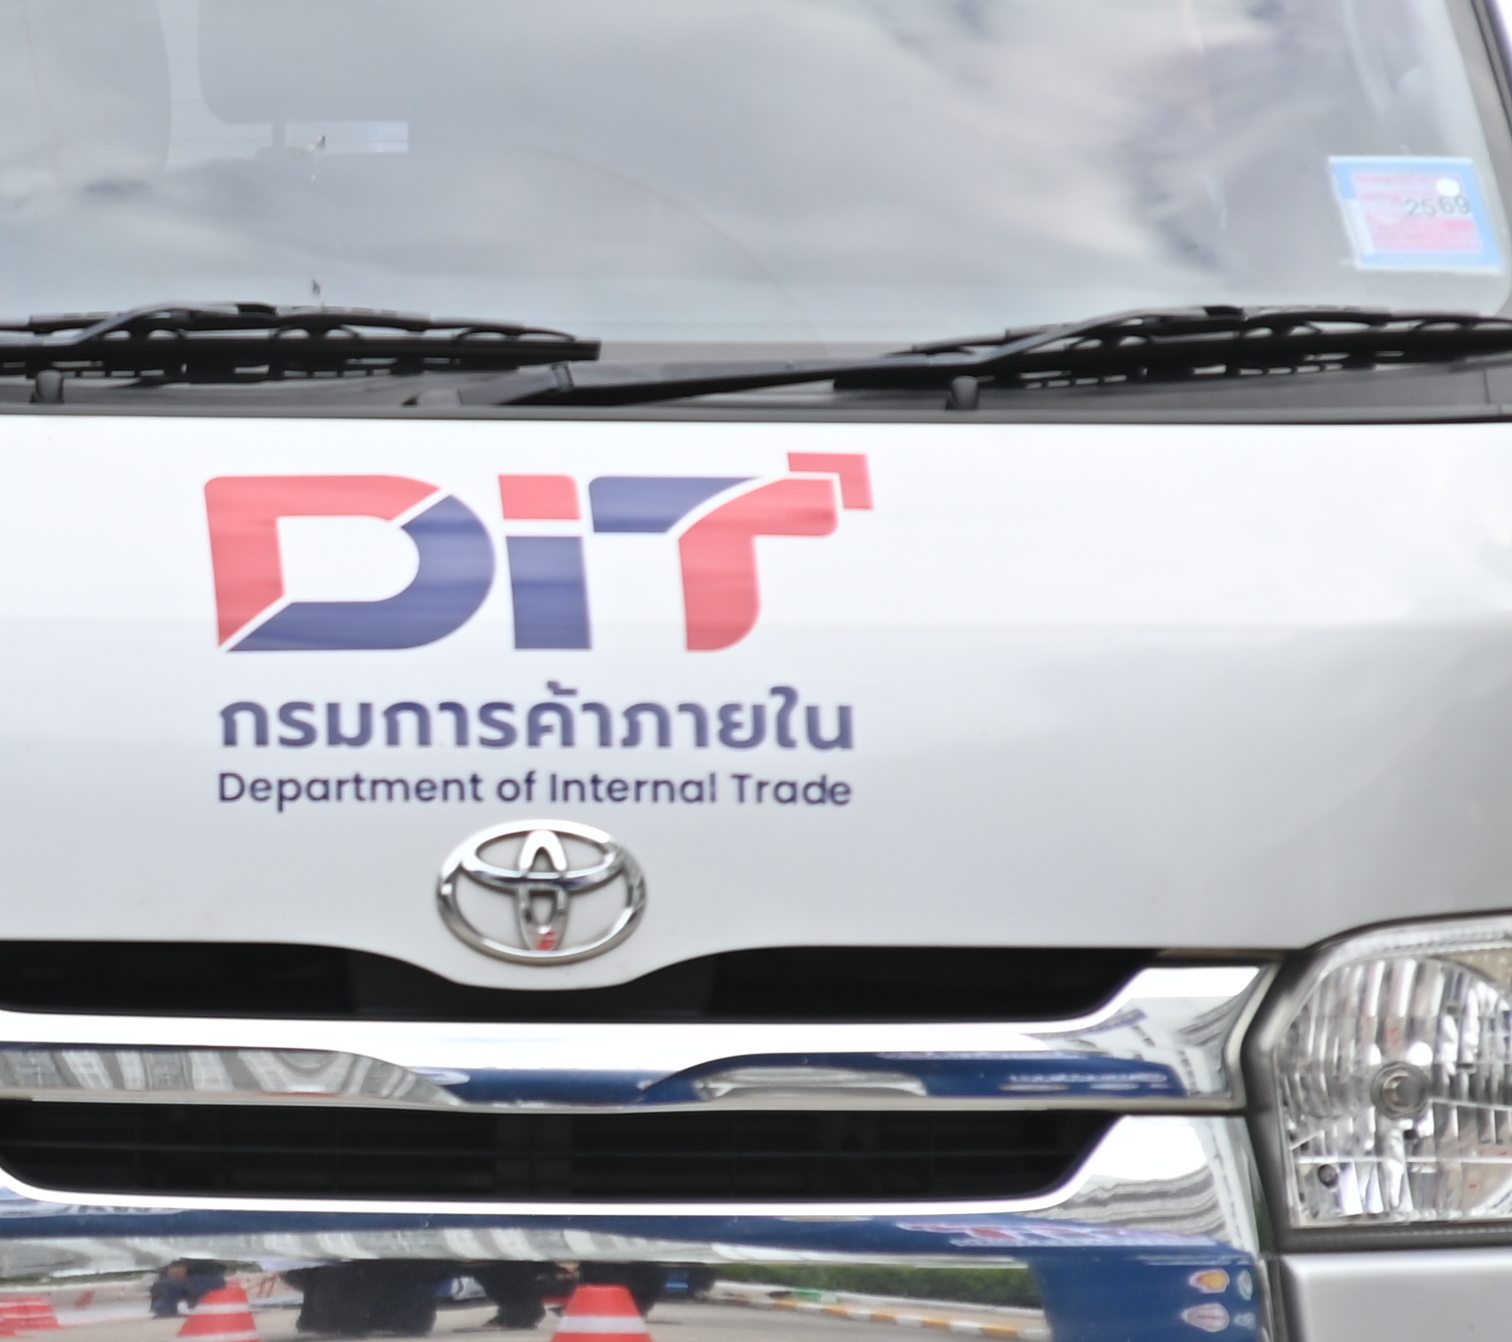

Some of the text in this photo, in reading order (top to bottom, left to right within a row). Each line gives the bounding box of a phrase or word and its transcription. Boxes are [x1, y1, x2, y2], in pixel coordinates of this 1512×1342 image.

[1406, 194, 1470, 218] 2569
[219, 681, 854, 751] กรมการค้าภายใน
[218, 770, 853, 814] Department of Internal Trade
